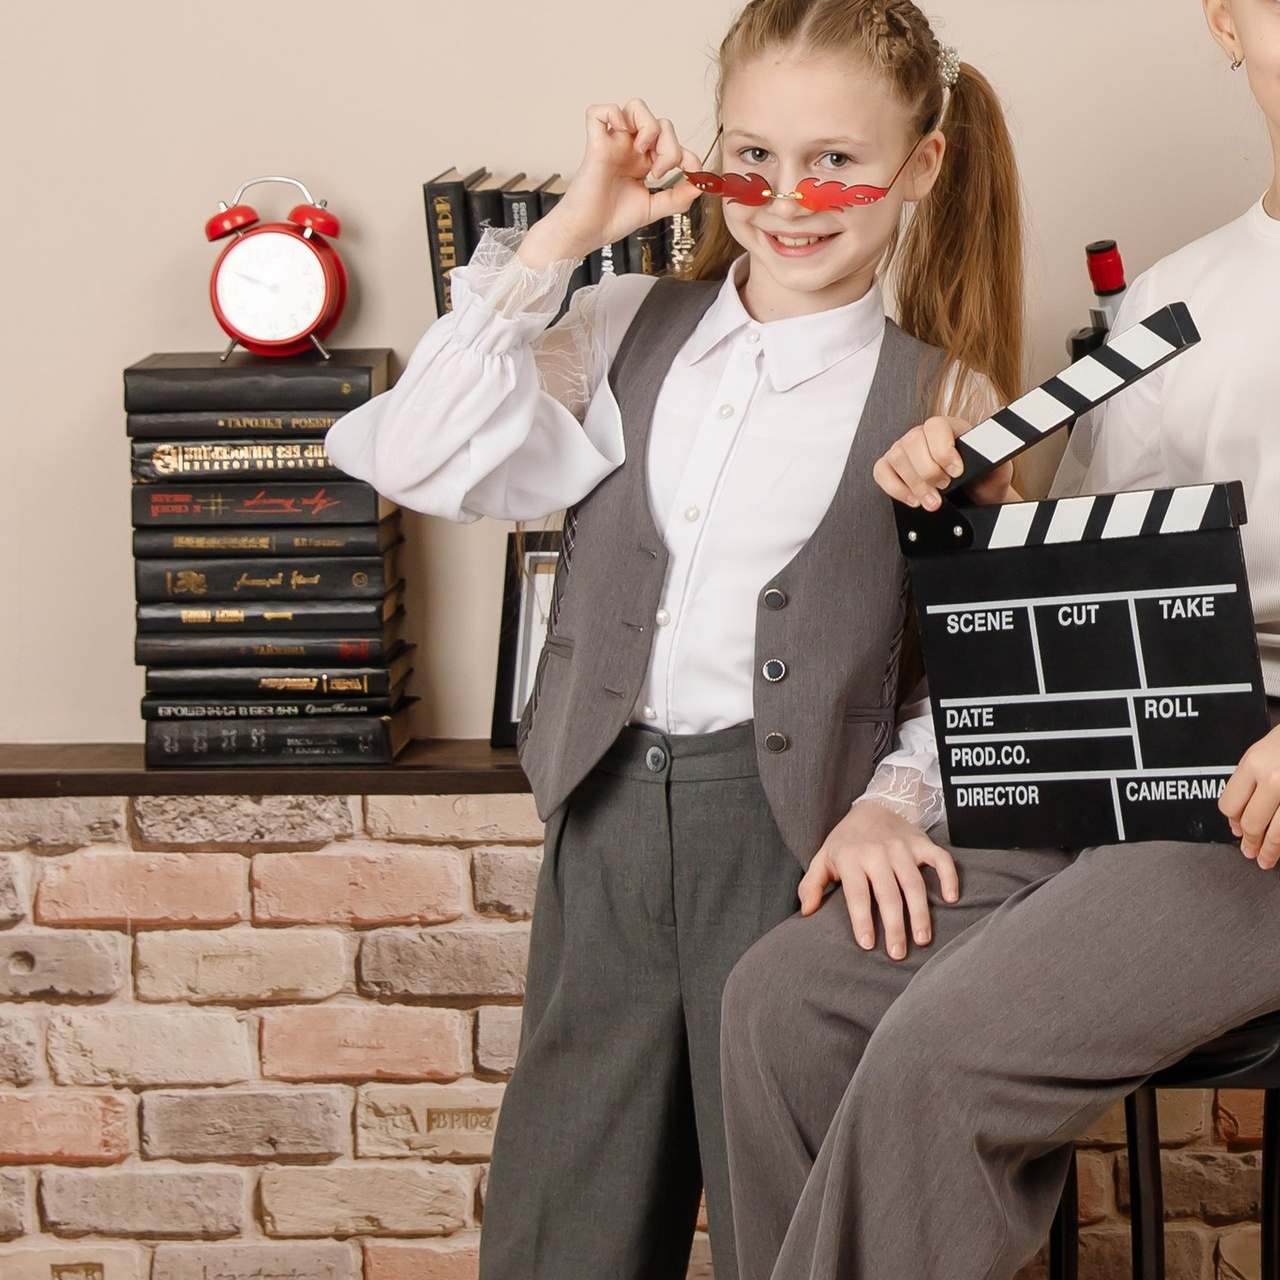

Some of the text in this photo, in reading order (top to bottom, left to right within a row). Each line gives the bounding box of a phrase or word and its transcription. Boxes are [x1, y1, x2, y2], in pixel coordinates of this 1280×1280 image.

[946, 596, 1215, 635] SCENE CUT TAKE
[946, 707, 994, 729] DATE
[1144, 697, 1200, 719] ROLL
[951, 745, 1030, 768] PROD.CO.
[956, 785, 1040, 807] DIRECTOR
